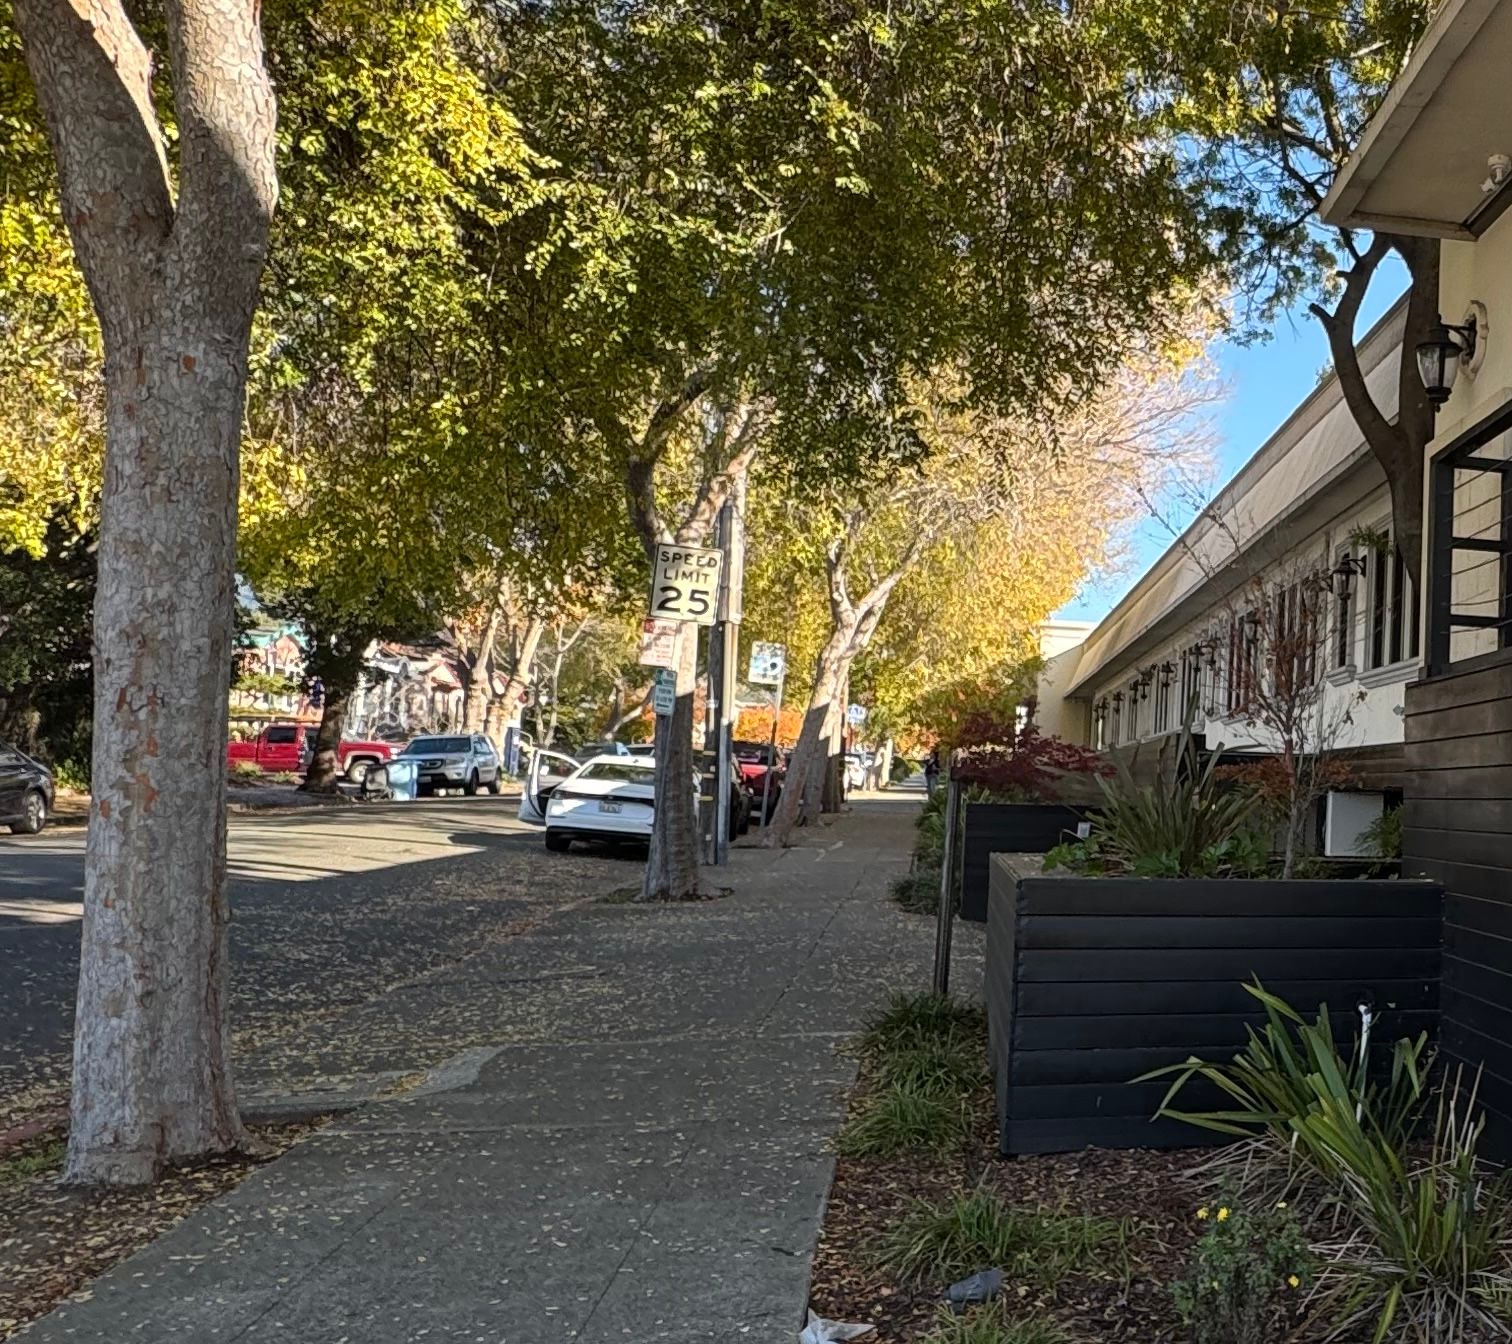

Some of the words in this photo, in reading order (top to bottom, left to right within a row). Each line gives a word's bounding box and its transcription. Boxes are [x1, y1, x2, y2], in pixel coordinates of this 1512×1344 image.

[660, 551, 718, 568] SPEED
[664, 568, 710, 584] LIMIT
[656, 586, 710, 616] 25
